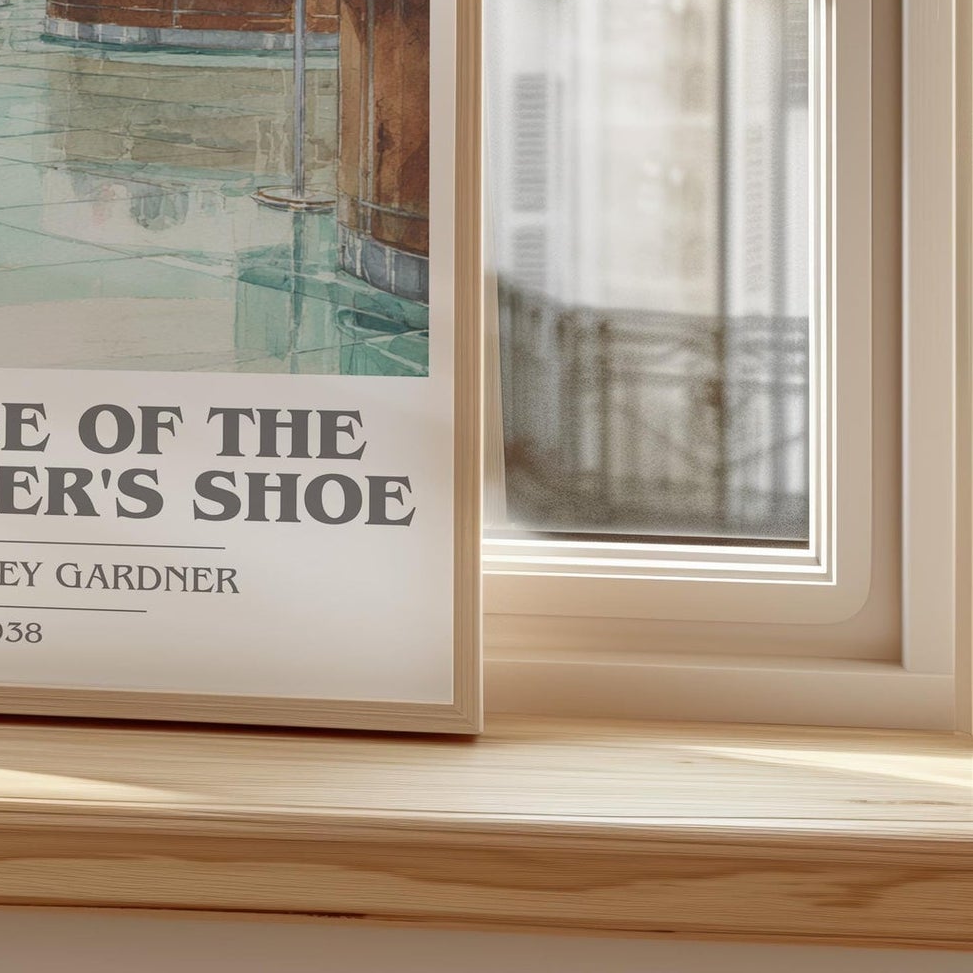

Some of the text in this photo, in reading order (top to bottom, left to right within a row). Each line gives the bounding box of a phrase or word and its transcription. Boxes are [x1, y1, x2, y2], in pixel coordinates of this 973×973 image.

[78, 403, 184, 457] OF
[206, 406, 368, 461] THE
[192, 470, 417, 527] SHOE
[55, 562, 240, 594] GARDNER
